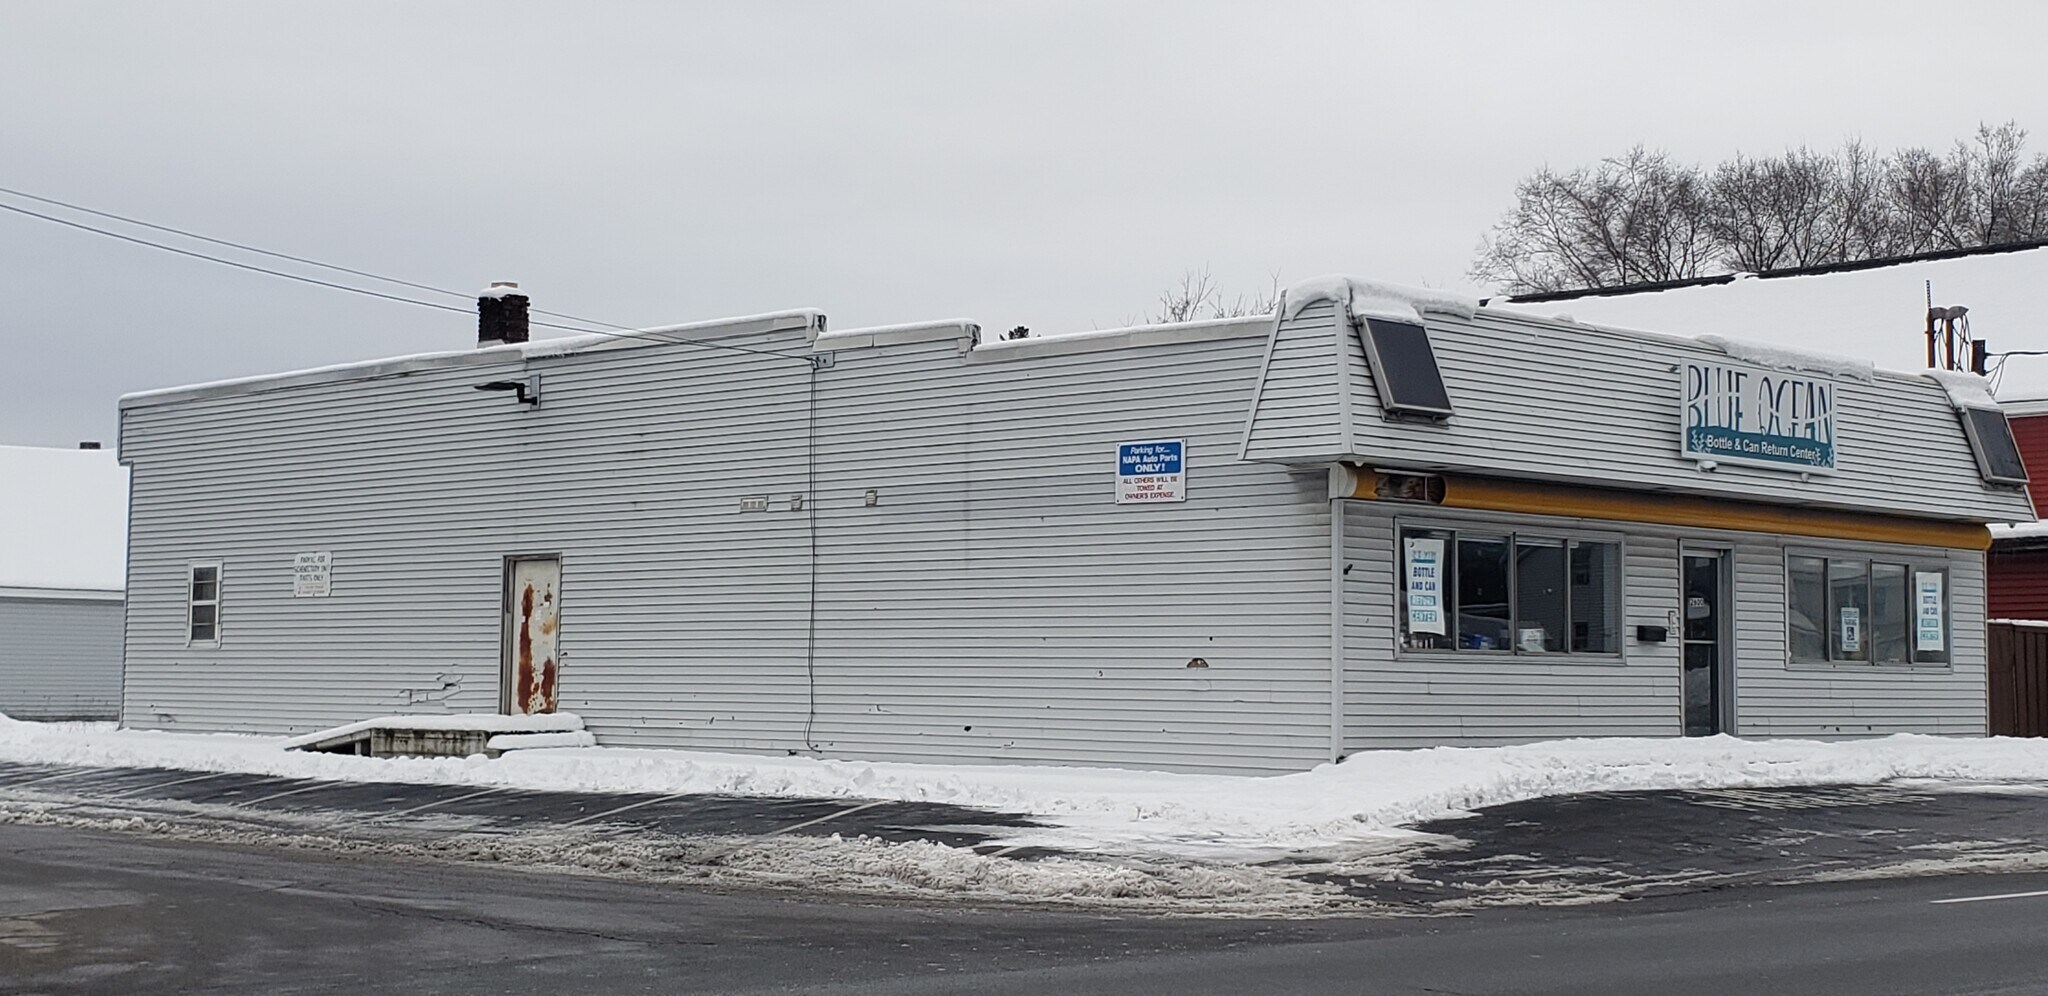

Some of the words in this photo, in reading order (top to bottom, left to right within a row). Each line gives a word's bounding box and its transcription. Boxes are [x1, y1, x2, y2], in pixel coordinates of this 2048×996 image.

[1688, 364, 1748, 432] BLUE
[1758, 376, 1833, 444] OCEAN
[1130, 446, 1153, 455] Parking
[1706, 434, 1732, 450] Bottle
[1734, 438, 1741, 451] &
[1742, 439, 1760, 453] Can
[1761, 442, 1788, 457] Return
[1790, 445, 1815, 460] Center
[1122, 456, 1141, 464] NAPA
[1142, 455, 1158, 463] Auto
[1160, 454, 1178, 462] Parts
[1135, 463, 1166, 473] ONLY!
[1125, 492, 1148, 500] OWNER'S
[1413, 567, 1435, 578] BOTTLE
[1411, 581, 1423, 590] AND
[1424, 581, 1436, 591] CAN
